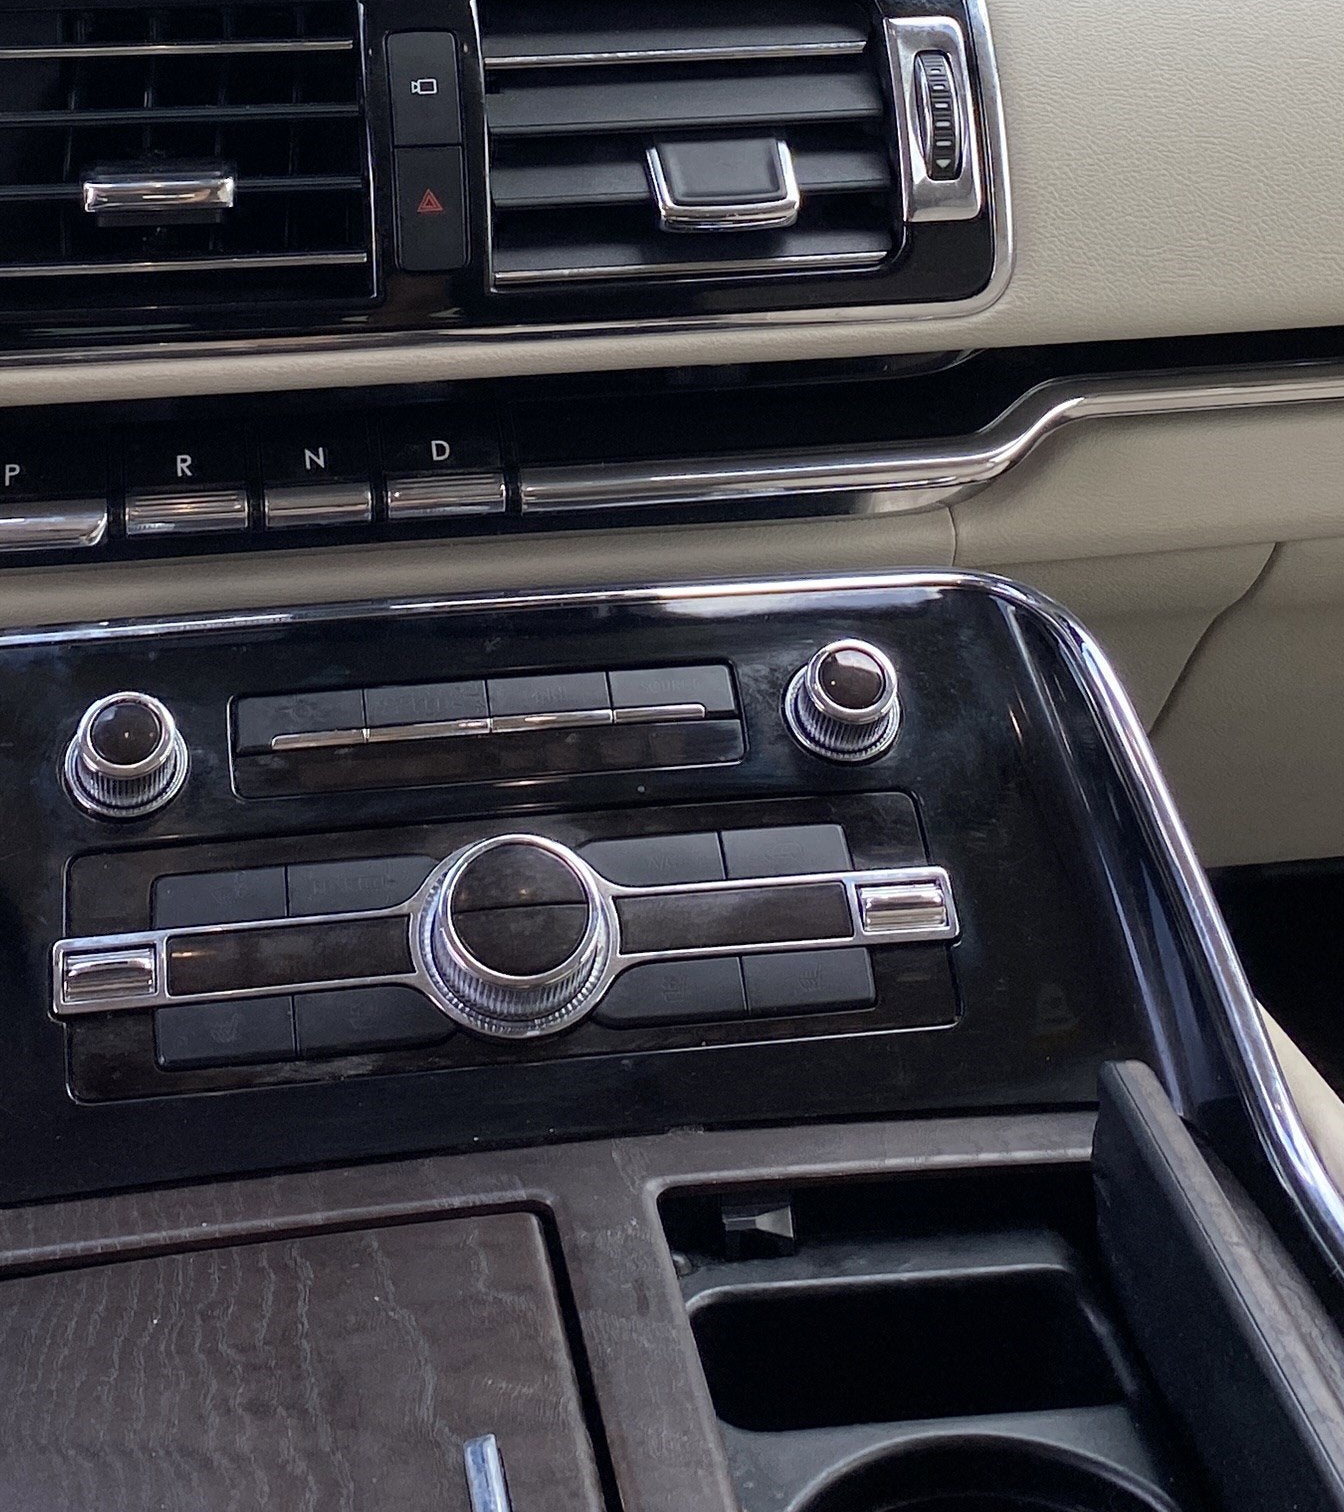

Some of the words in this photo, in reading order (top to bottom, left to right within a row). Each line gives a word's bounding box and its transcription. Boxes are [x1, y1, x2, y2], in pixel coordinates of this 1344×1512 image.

[4, 464, 21, 486] P
[176, 454, 192, 477] R
[304, 446, 324, 470] N
[431, 440, 450, 461] D
